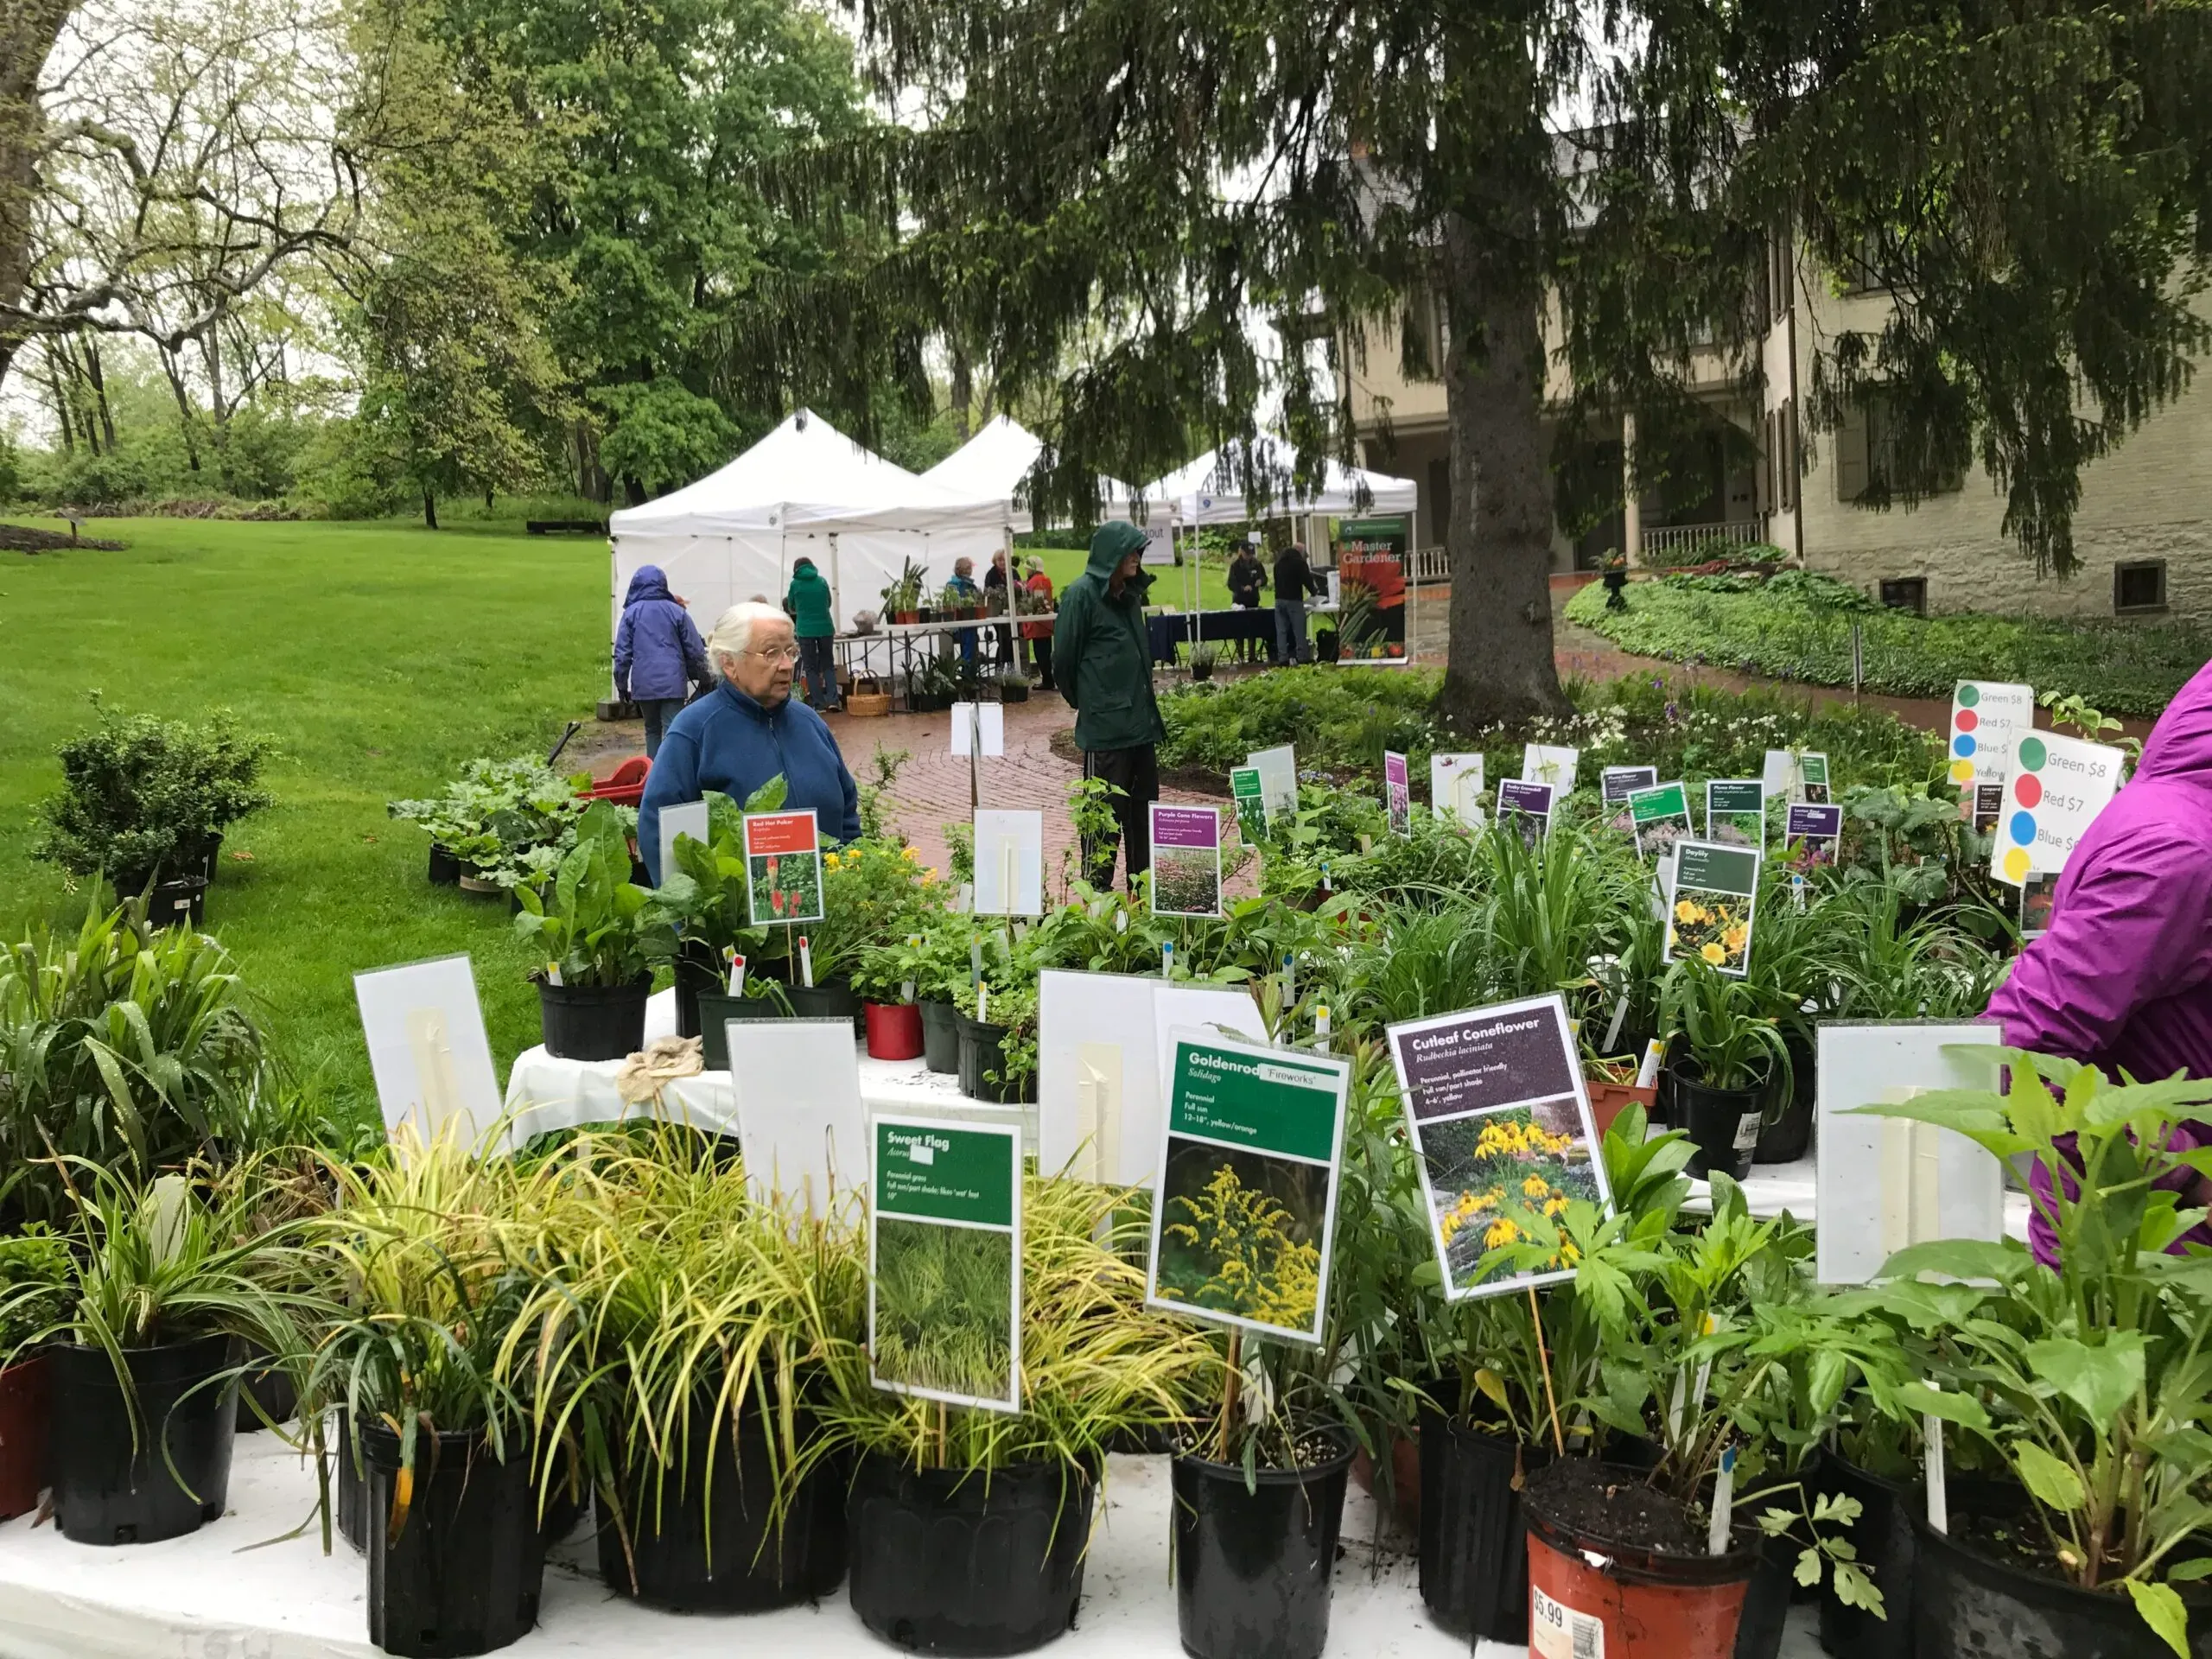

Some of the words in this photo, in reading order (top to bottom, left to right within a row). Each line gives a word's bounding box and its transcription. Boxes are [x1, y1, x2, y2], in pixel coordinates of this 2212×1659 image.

[1351, 541, 1393, 552] Master
[1343, 552, 1402, 564] Gardener
[1981, 693, 2009, 703] Green
[2011, 695, 2023, 705] $8
[1980, 717, 1998, 727] Red
[1999, 718, 2011, 729] $7
[1977, 743, 1999, 753] Blue
[2048, 753, 2085, 773] Green
[2088, 761, 2107, 779] $8
[2043, 790, 2066, 808] Red
[2068, 797, 2084, 812] $7
[2037, 828, 2063, 849] Blue
[1685, 849, 1709, 858] Daylily
[1412, 1031, 1459, 1051] Cutleaf
[1462, 1018, 1541, 1042] Coneflower
[1414, 1050, 1458, 1064] Rudbeckia
[1458, 1042, 1494, 1057] laciniata
[1188, 1052, 1261, 1077] Goldenrod
[1420, 1072, 1452, 1085] Perennial,
[1452, 1067, 1482, 1080] pollinator
[1483, 1061, 1508, 1073] friendly
[1187, 1066, 1223, 1084] Solidago
[1435, 1082, 1464, 1095] sun/part
[1464, 1077, 1484, 1089] shade
[1185, 1090, 1215, 1103] Perennial
[1442, 1092, 1464, 1105] yellow
[1184, 1102, 1196, 1112] Full
[1196, 1104, 1208, 1113] sun
[1211, 1119, 1257, 1135] yellow/orange
[887, 1131, 922, 1145] Sweet
[925, 1134, 950, 1153] Flag
[887, 1147, 910, 1158] Acoru
[1534, 1590, 1563, 1628] $5.99
